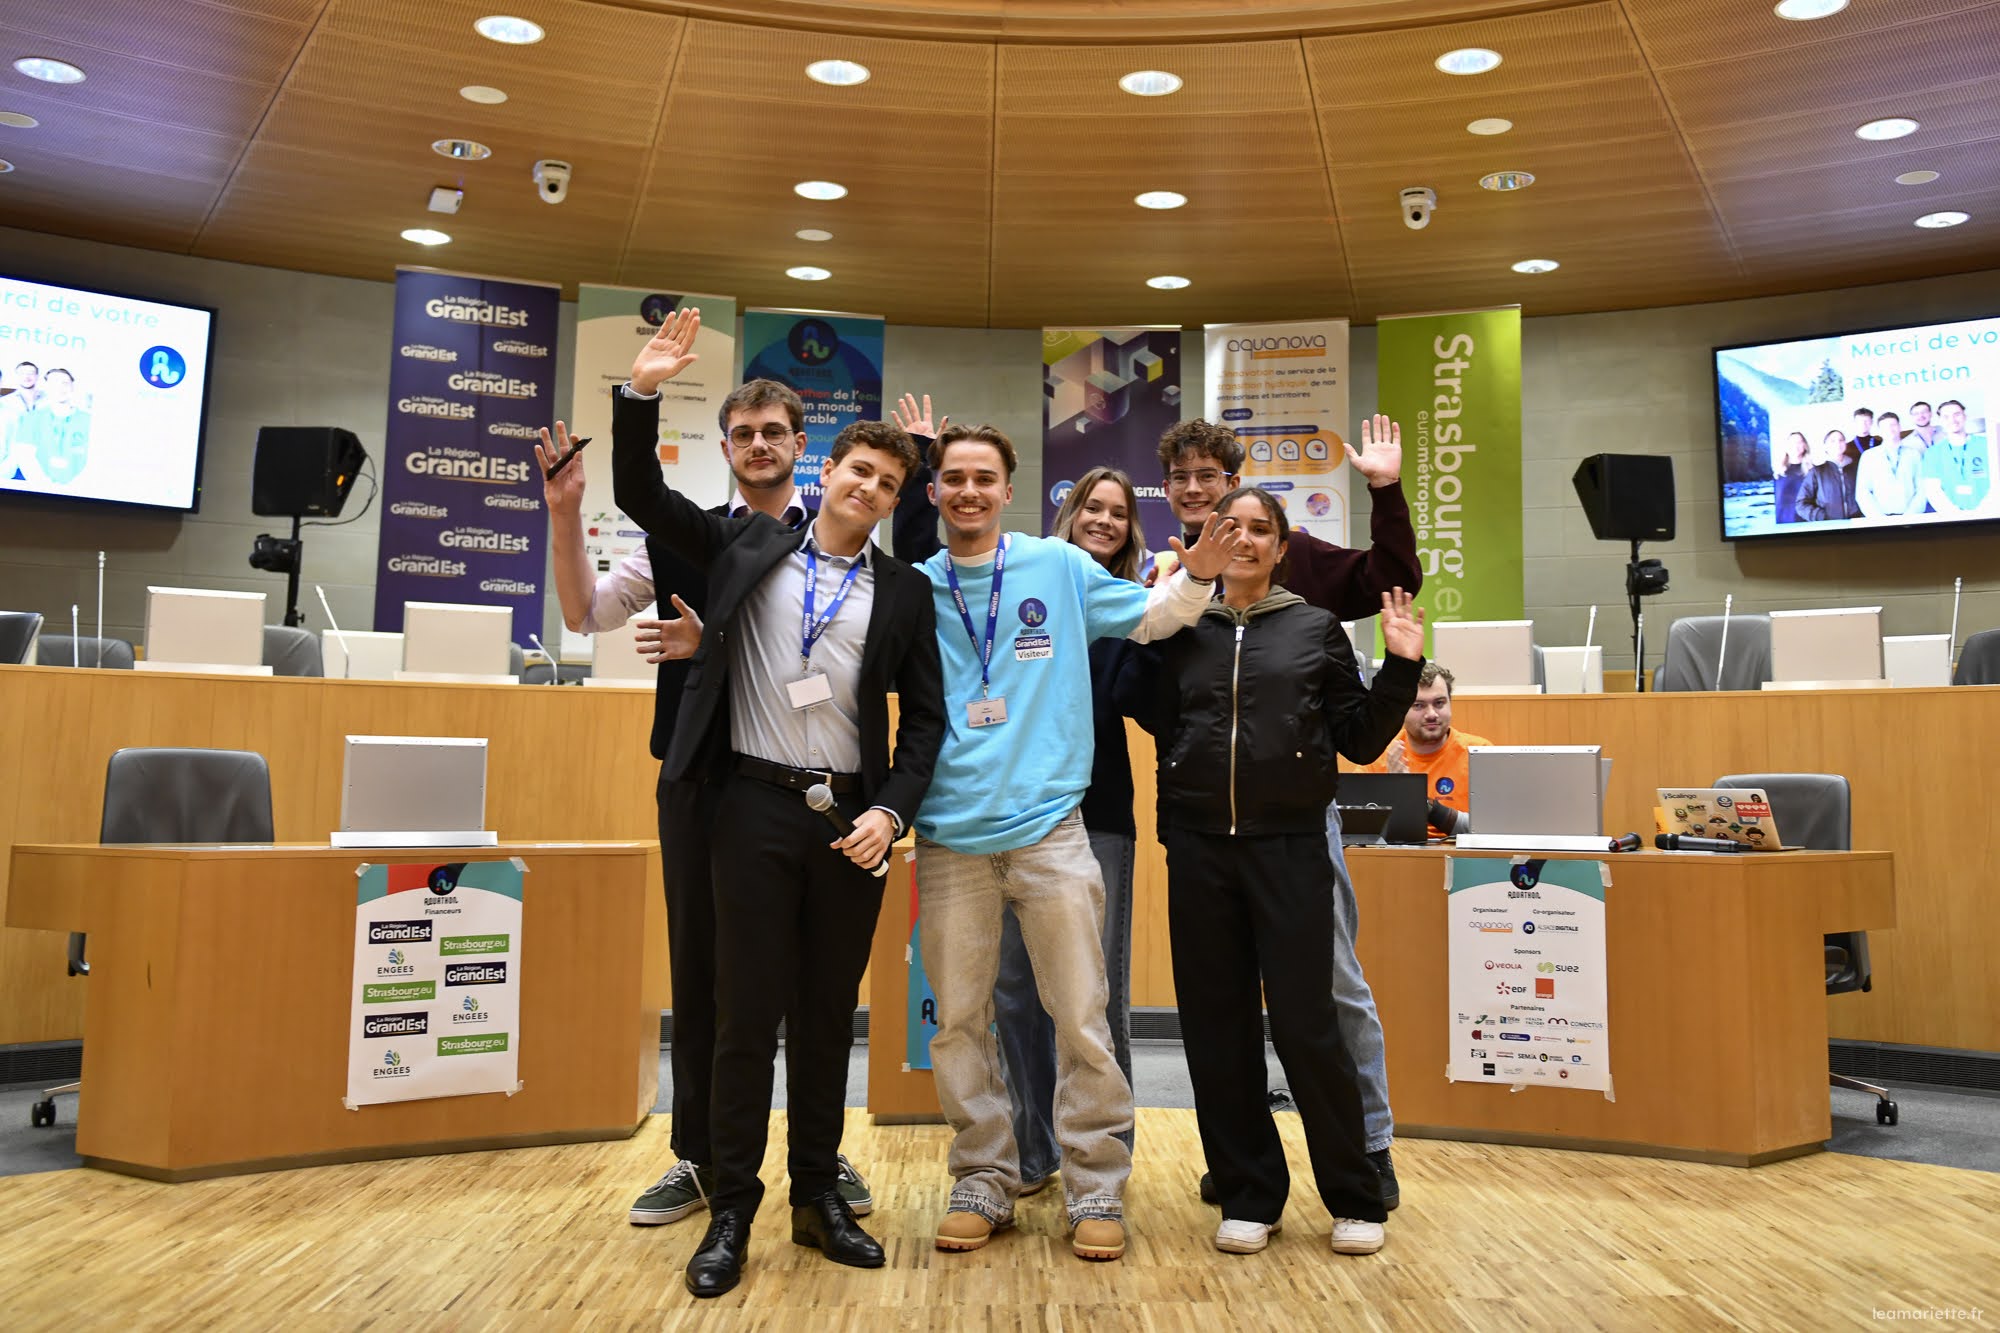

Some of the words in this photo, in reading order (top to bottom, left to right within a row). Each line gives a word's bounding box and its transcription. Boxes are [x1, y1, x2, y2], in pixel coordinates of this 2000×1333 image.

[0, 290, 38, 309] rci
[48, 296, 81, 316] de
[90, 305, 160, 328] votre
[0, 325, 87, 350] ention
[1227, 334, 1326, 360] aquanova
[1852, 335, 1919, 359] Merci
[1928, 332, 1959, 350] de
[1853, 361, 1971, 390] attention
[833, 389, 849, 400] de
[818, 401, 863, 413] monde
[803, 413, 838, 424] rable
[1417, 410, 1434, 540] eurométropole
[1018, 650, 1049, 658] Visiteur
[424, 908, 461, 916] Financeurs
[377, 965, 414, 975] ENGEES
[1555, 964, 1579, 972] suez
[453, 1012, 488, 1021] ENGEES
[373, 1066, 410, 1076] ENGEES
